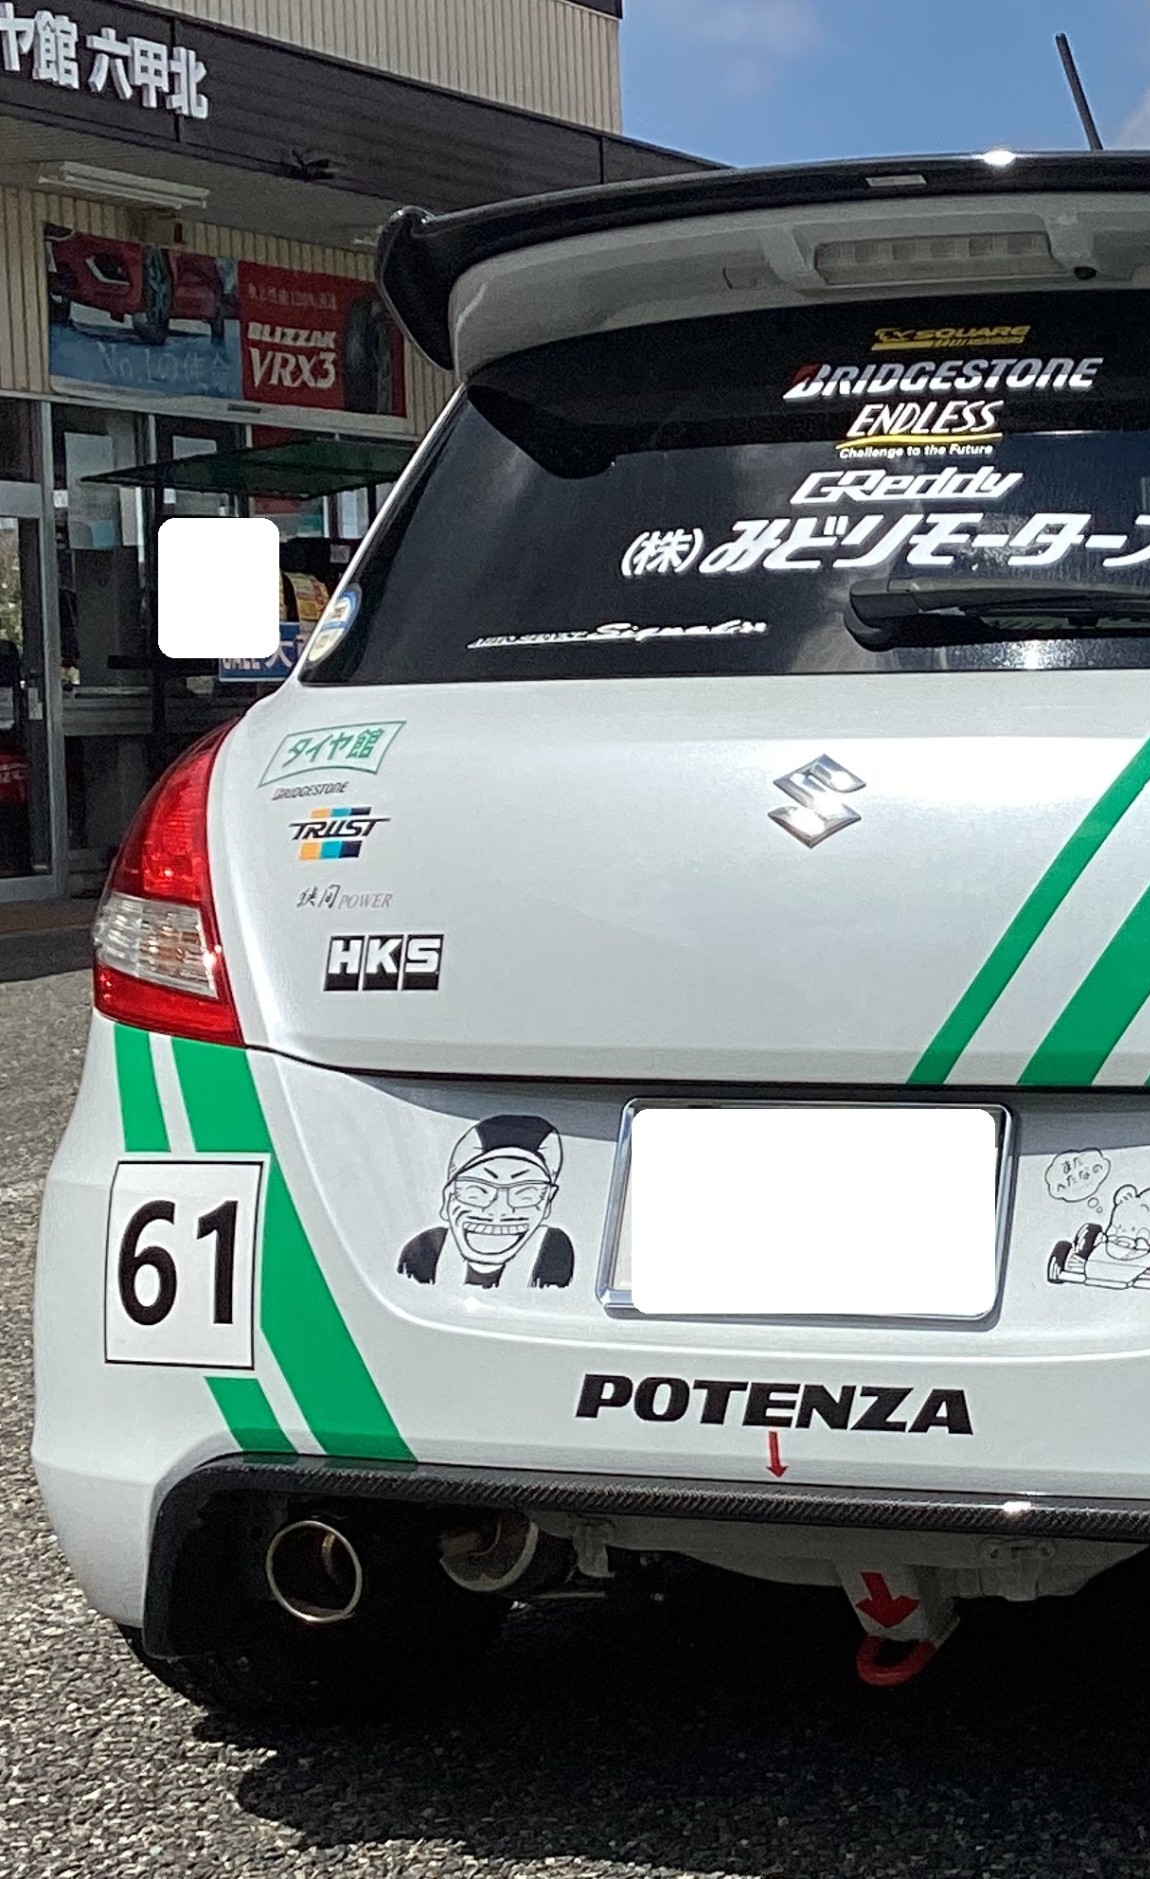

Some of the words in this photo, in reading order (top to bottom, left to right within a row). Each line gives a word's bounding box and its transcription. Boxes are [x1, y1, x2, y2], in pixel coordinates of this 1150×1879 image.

[86, 27, 209, 119] 六甲北
[914, 325, 1031, 340] SQUARE
[248, 347, 337, 390] VRX3
[783, 357, 1103, 399] BRIDGESTONE
[846, 400, 1004, 438] ENDLESS
[839, 445, 903, 459] Challenge
[906, 446, 921, 456] to
[923, 445, 946, 456] the
[949, 443, 993, 455] Future
[790, 466, 1023, 504] GReddy
[281, 727, 385, 769] タイヤ館
[271, 781, 350, 801] BRIDGESTONE
[288, 817, 391, 840] TRUST
[325, 935, 443, 980] HKS
[118, 1199, 239, 1326] 61
[575, 1373, 974, 1435] POTENZA
